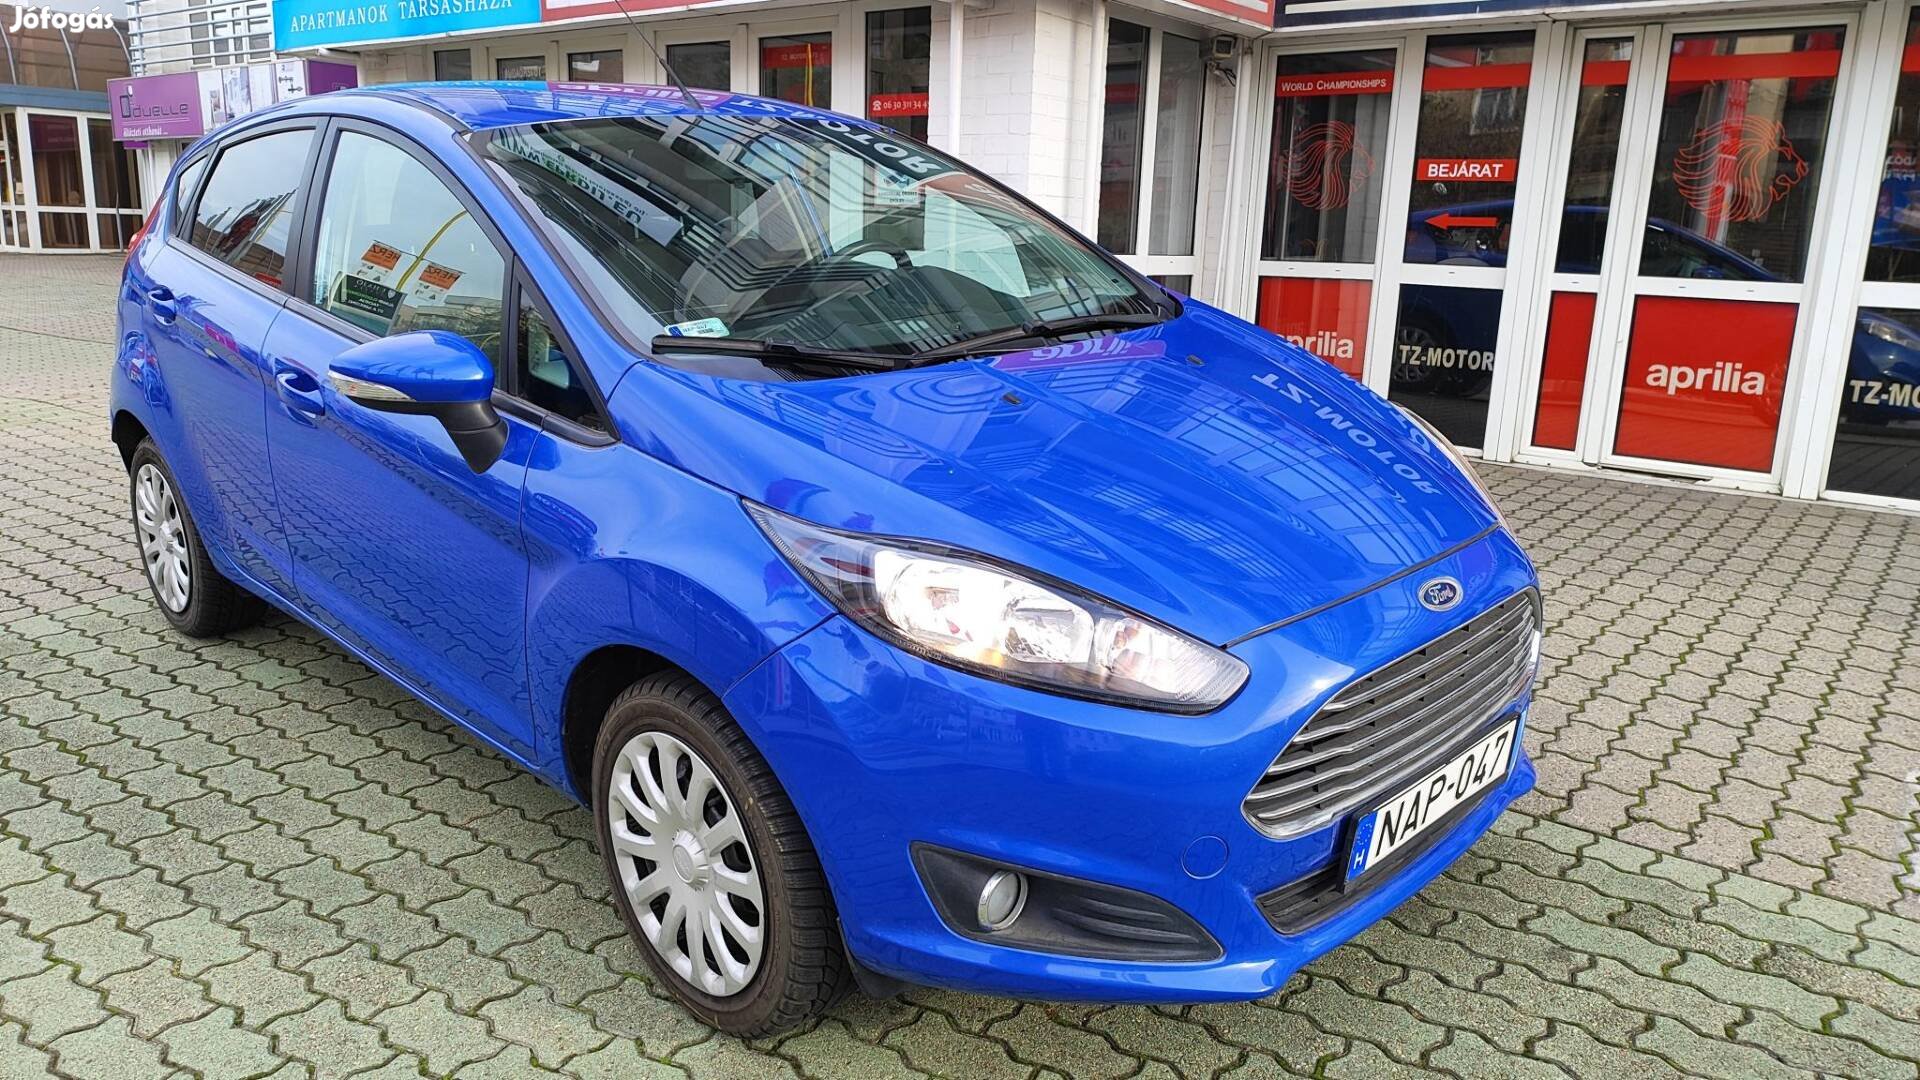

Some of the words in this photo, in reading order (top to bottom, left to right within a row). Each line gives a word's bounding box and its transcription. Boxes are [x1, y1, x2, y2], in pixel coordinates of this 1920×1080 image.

[290, 5, 389, 33] APARTMANOK
[1281, 82, 1314, 92] WORLD
[1316, 79, 1387, 91] CHAMPIONSHIPS
[883, 101, 892, 110] 06
[893, 101, 902, 110] 30
[912, 101, 922, 110] 34
[1427, 161, 1504, 178] BEJÁRAT
[1276, 331, 1354, 358] prilia
[1399, 345, 1495, 372] TZ-MOTOR
[1646, 361, 1766, 395] aprilia
[1428, 583, 1455, 605] Ford
[1375, 730, 1510, 858] NAP-047
[1353, 849, 1366, 870] H
